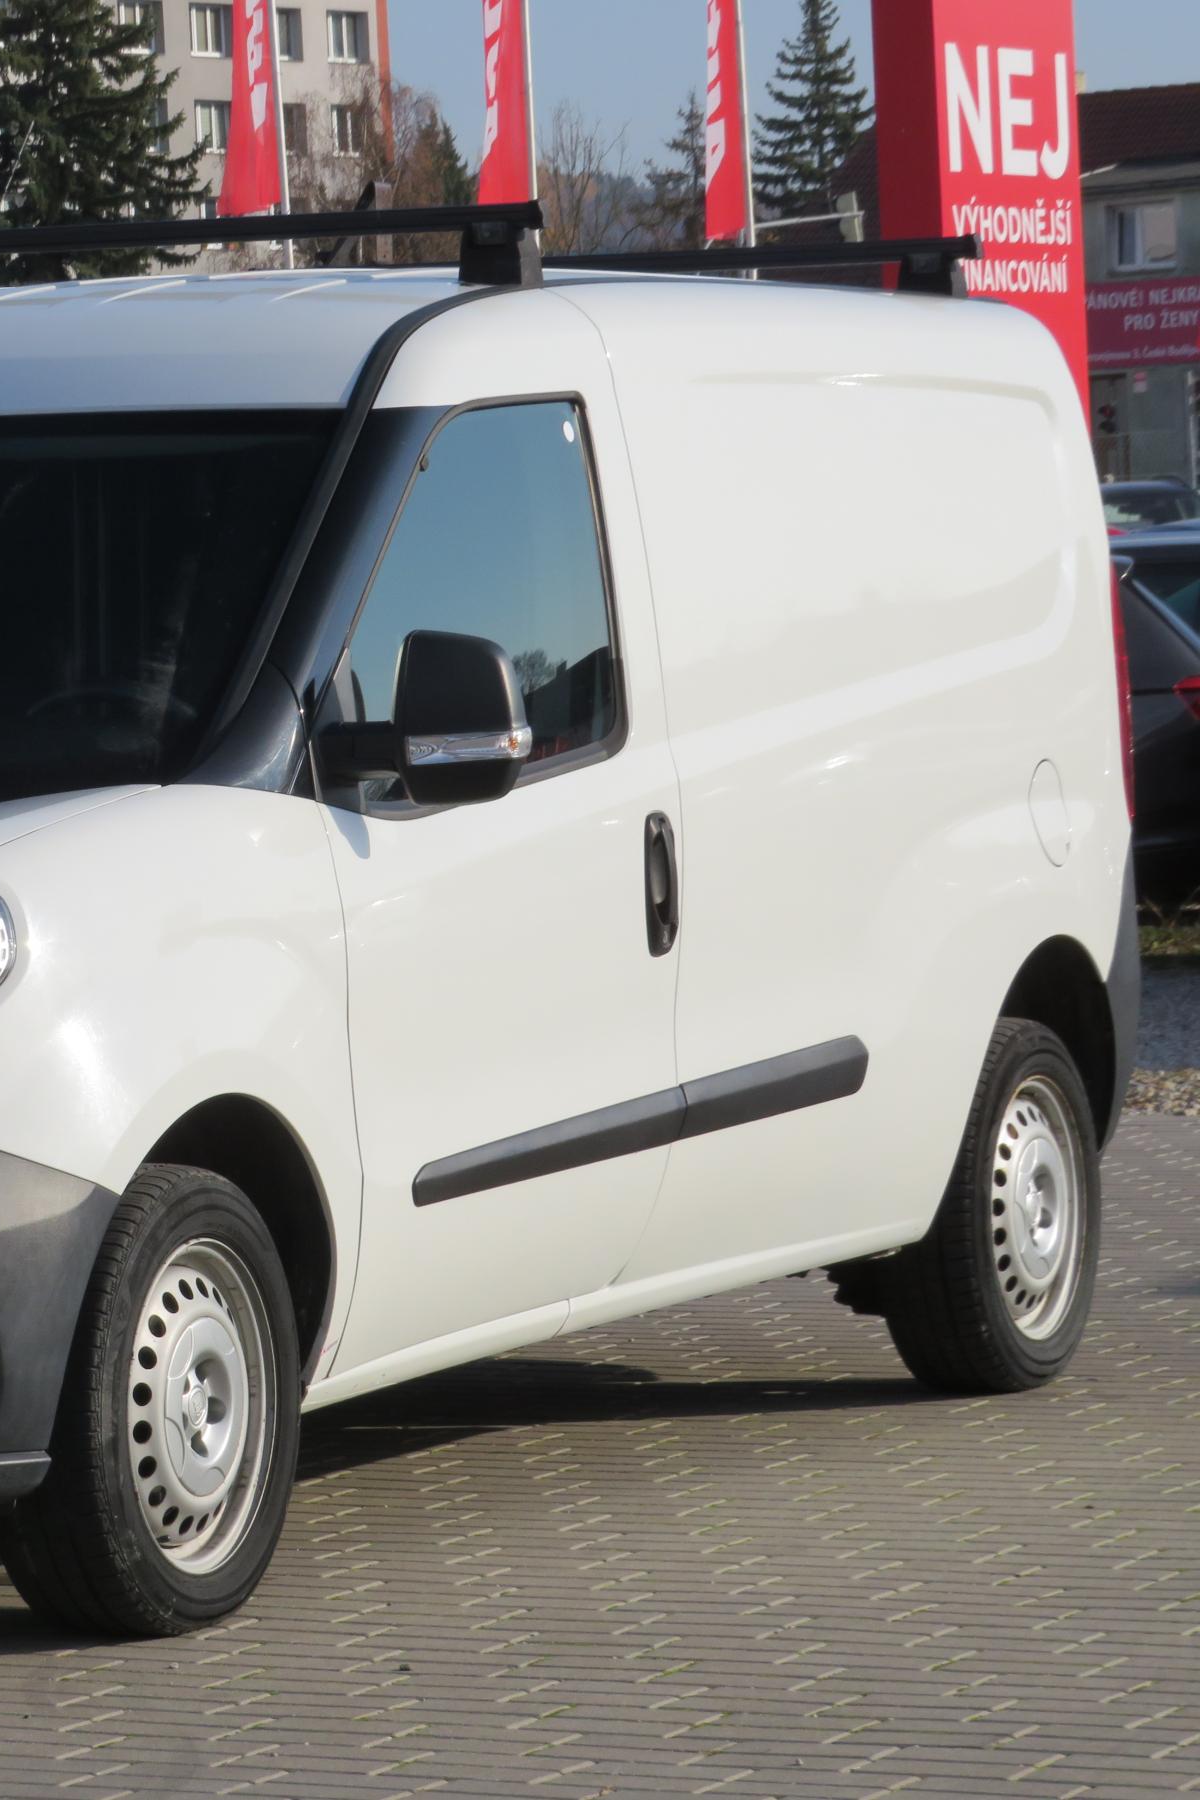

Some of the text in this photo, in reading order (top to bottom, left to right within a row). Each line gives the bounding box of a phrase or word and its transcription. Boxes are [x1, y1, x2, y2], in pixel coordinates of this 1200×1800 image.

[944, 42, 1070, 180] NEJ
[952, 195, 1072, 245] VÝHODNĚJŠÍ
[958, 253, 1069, 293] INANCOVÁNÍ
[1085, 287, 1144, 310] ÁNOVÉ!
[1124, 313, 1156, 331] PRO
